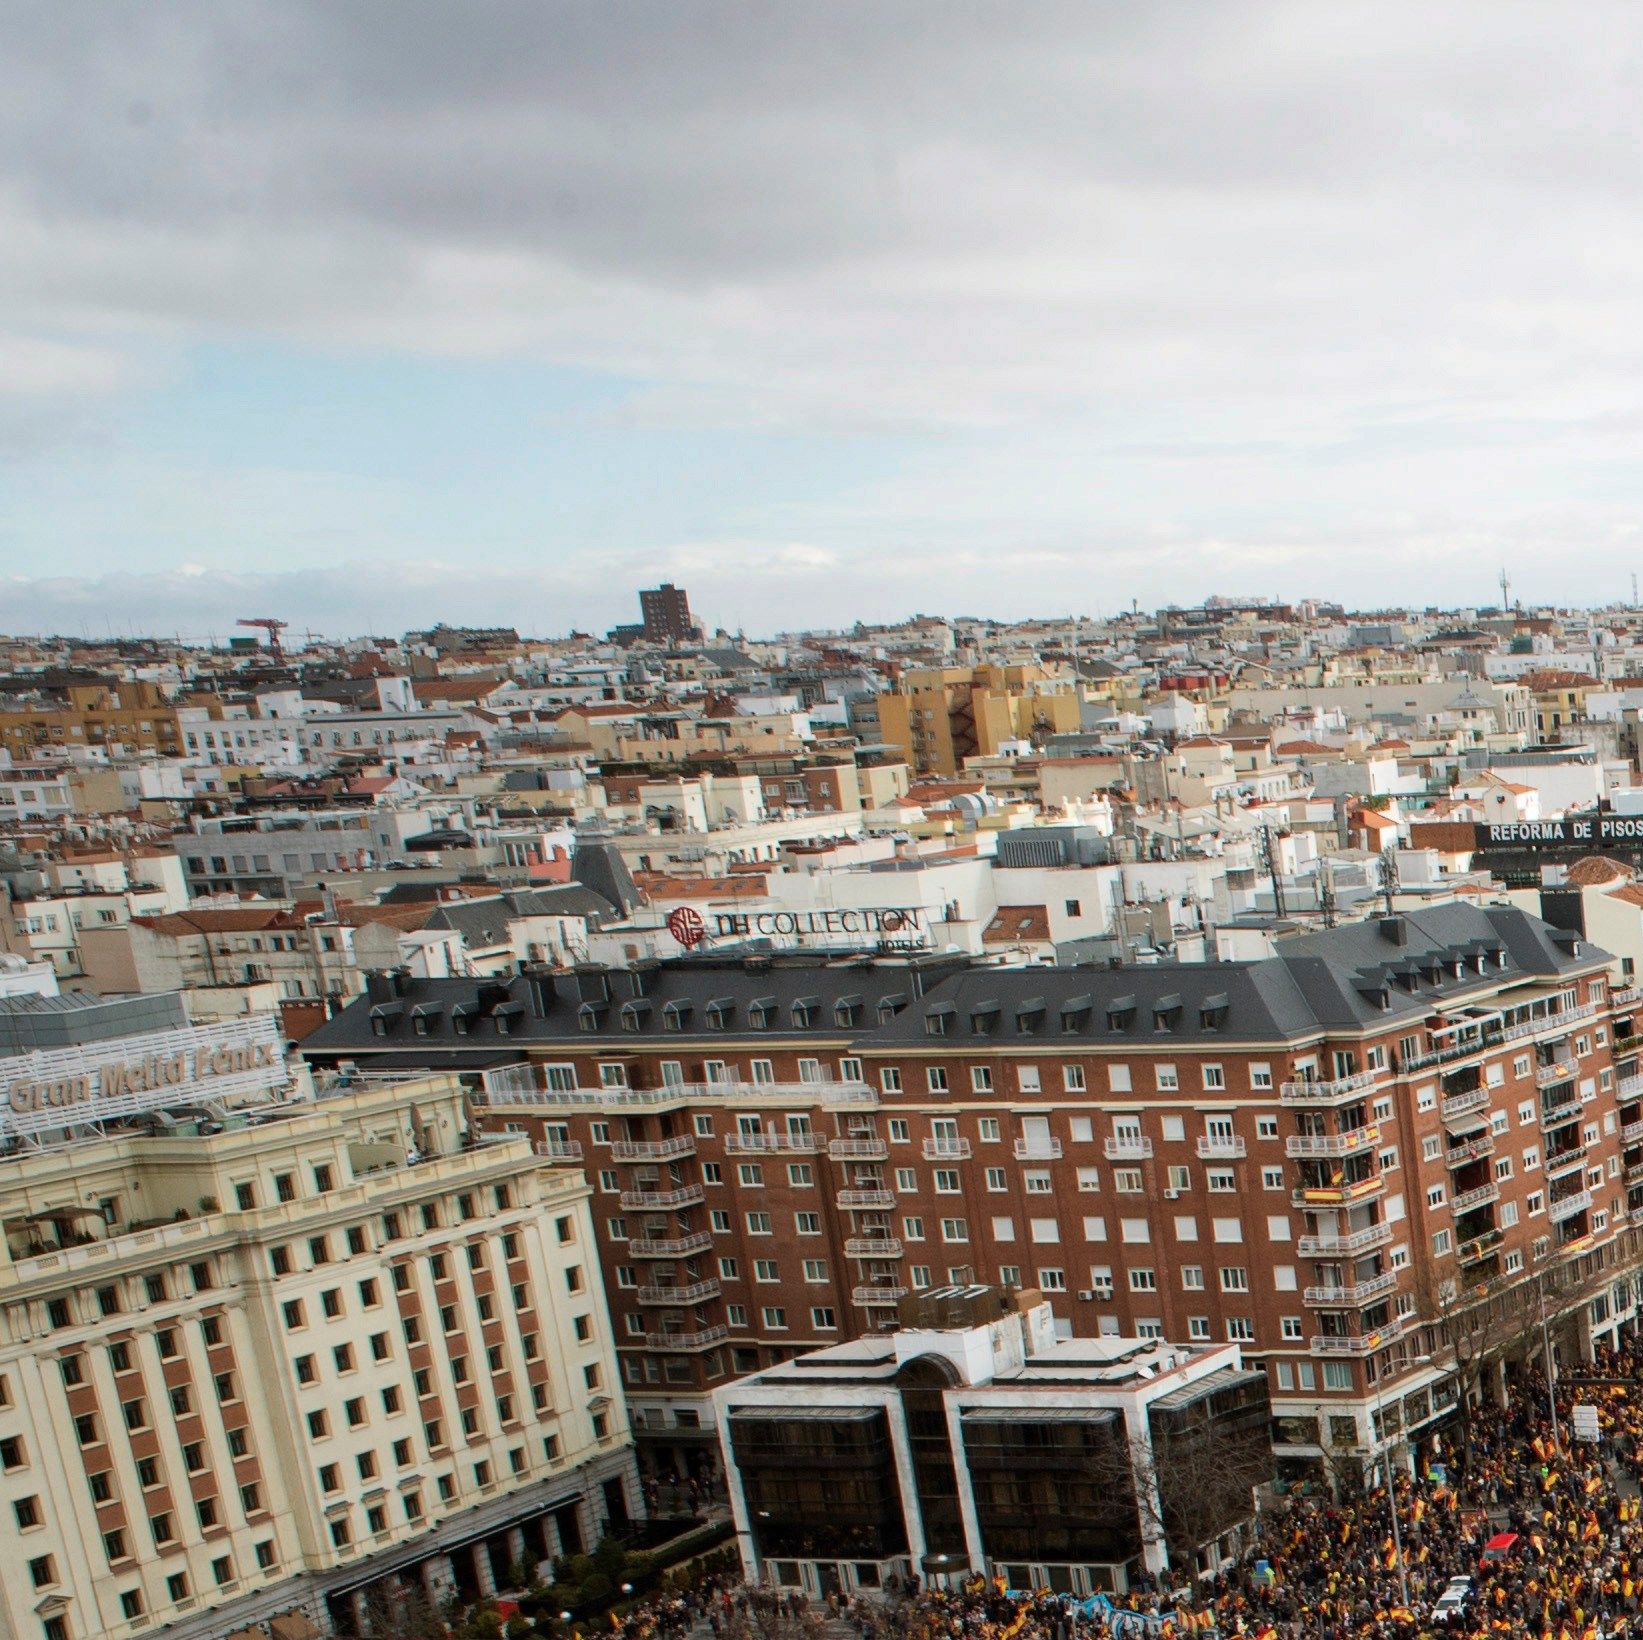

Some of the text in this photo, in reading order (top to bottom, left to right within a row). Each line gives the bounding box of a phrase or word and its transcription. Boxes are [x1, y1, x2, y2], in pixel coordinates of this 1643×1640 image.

[1490, 822, 1564, 841] REFORMA
[1573, 821, 1591, 839] DE
[757, 907, 921, 935] COLLECTION
[877, 938, 925, 951] HOTELS
[8, 1074, 91, 1114] Gran
